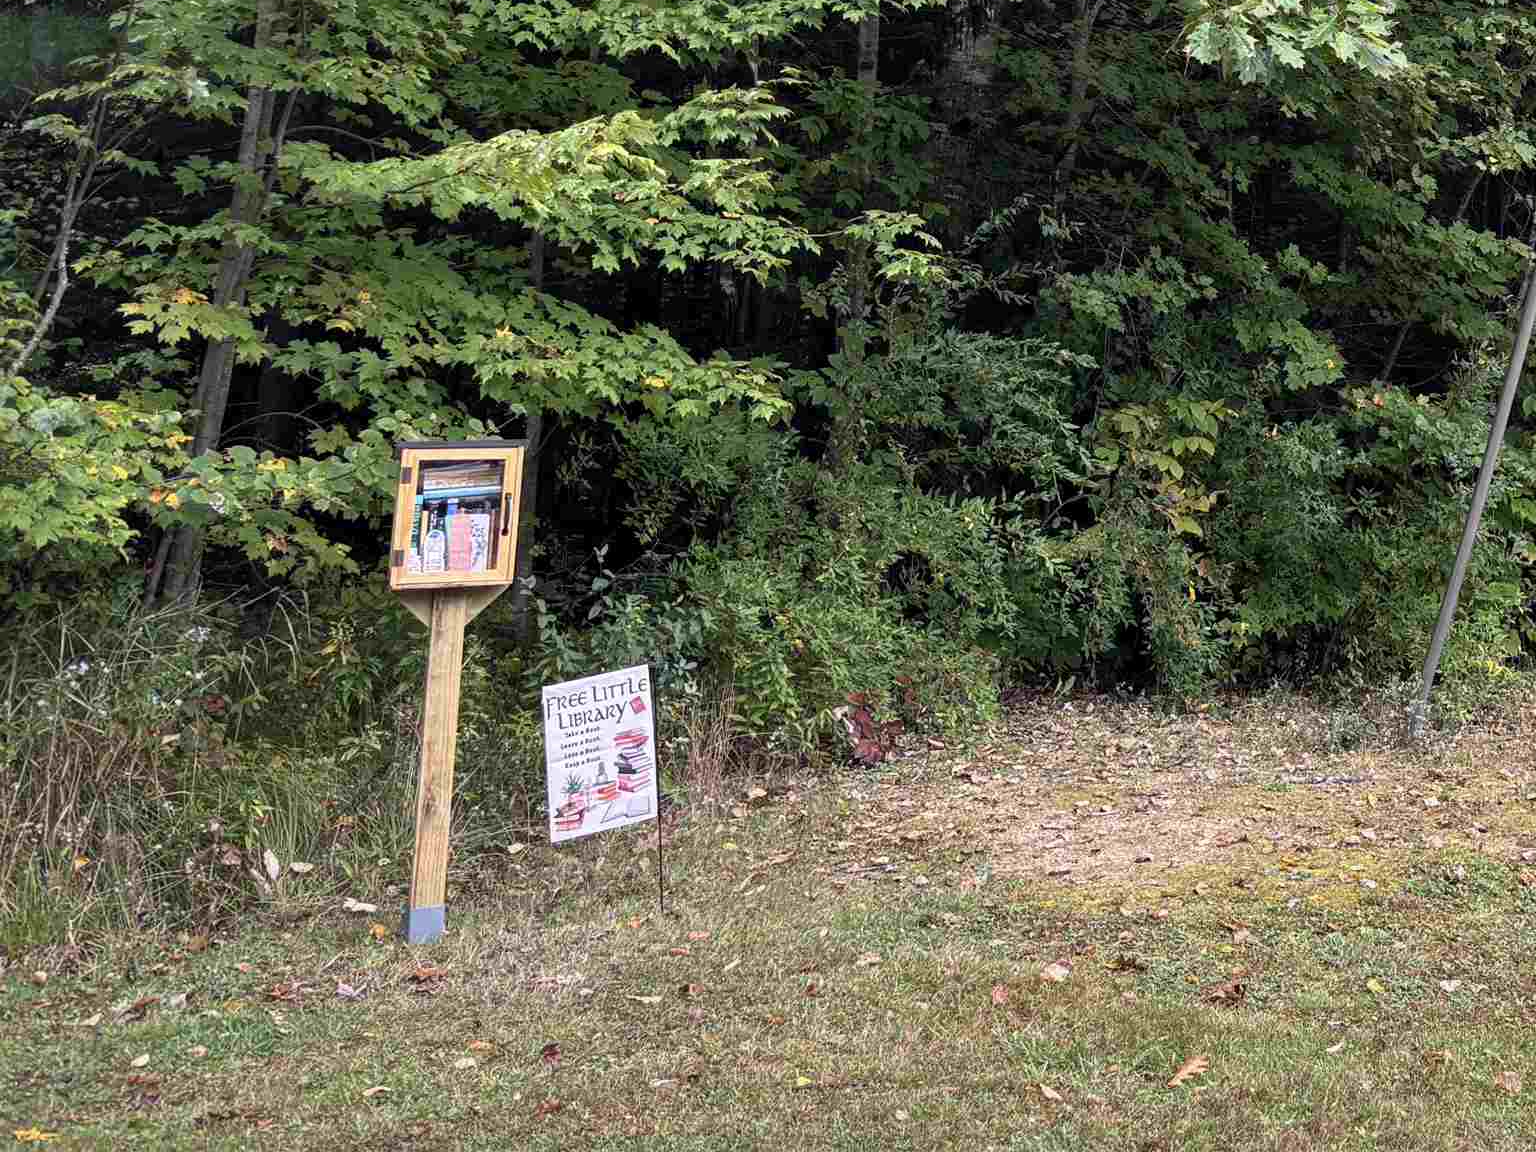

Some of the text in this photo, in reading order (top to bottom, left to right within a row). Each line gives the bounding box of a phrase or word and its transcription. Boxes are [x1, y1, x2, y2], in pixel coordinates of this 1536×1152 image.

[546, 678, 648, 720] FREE LITTLE
[558, 700, 627, 730] LIBRARY
